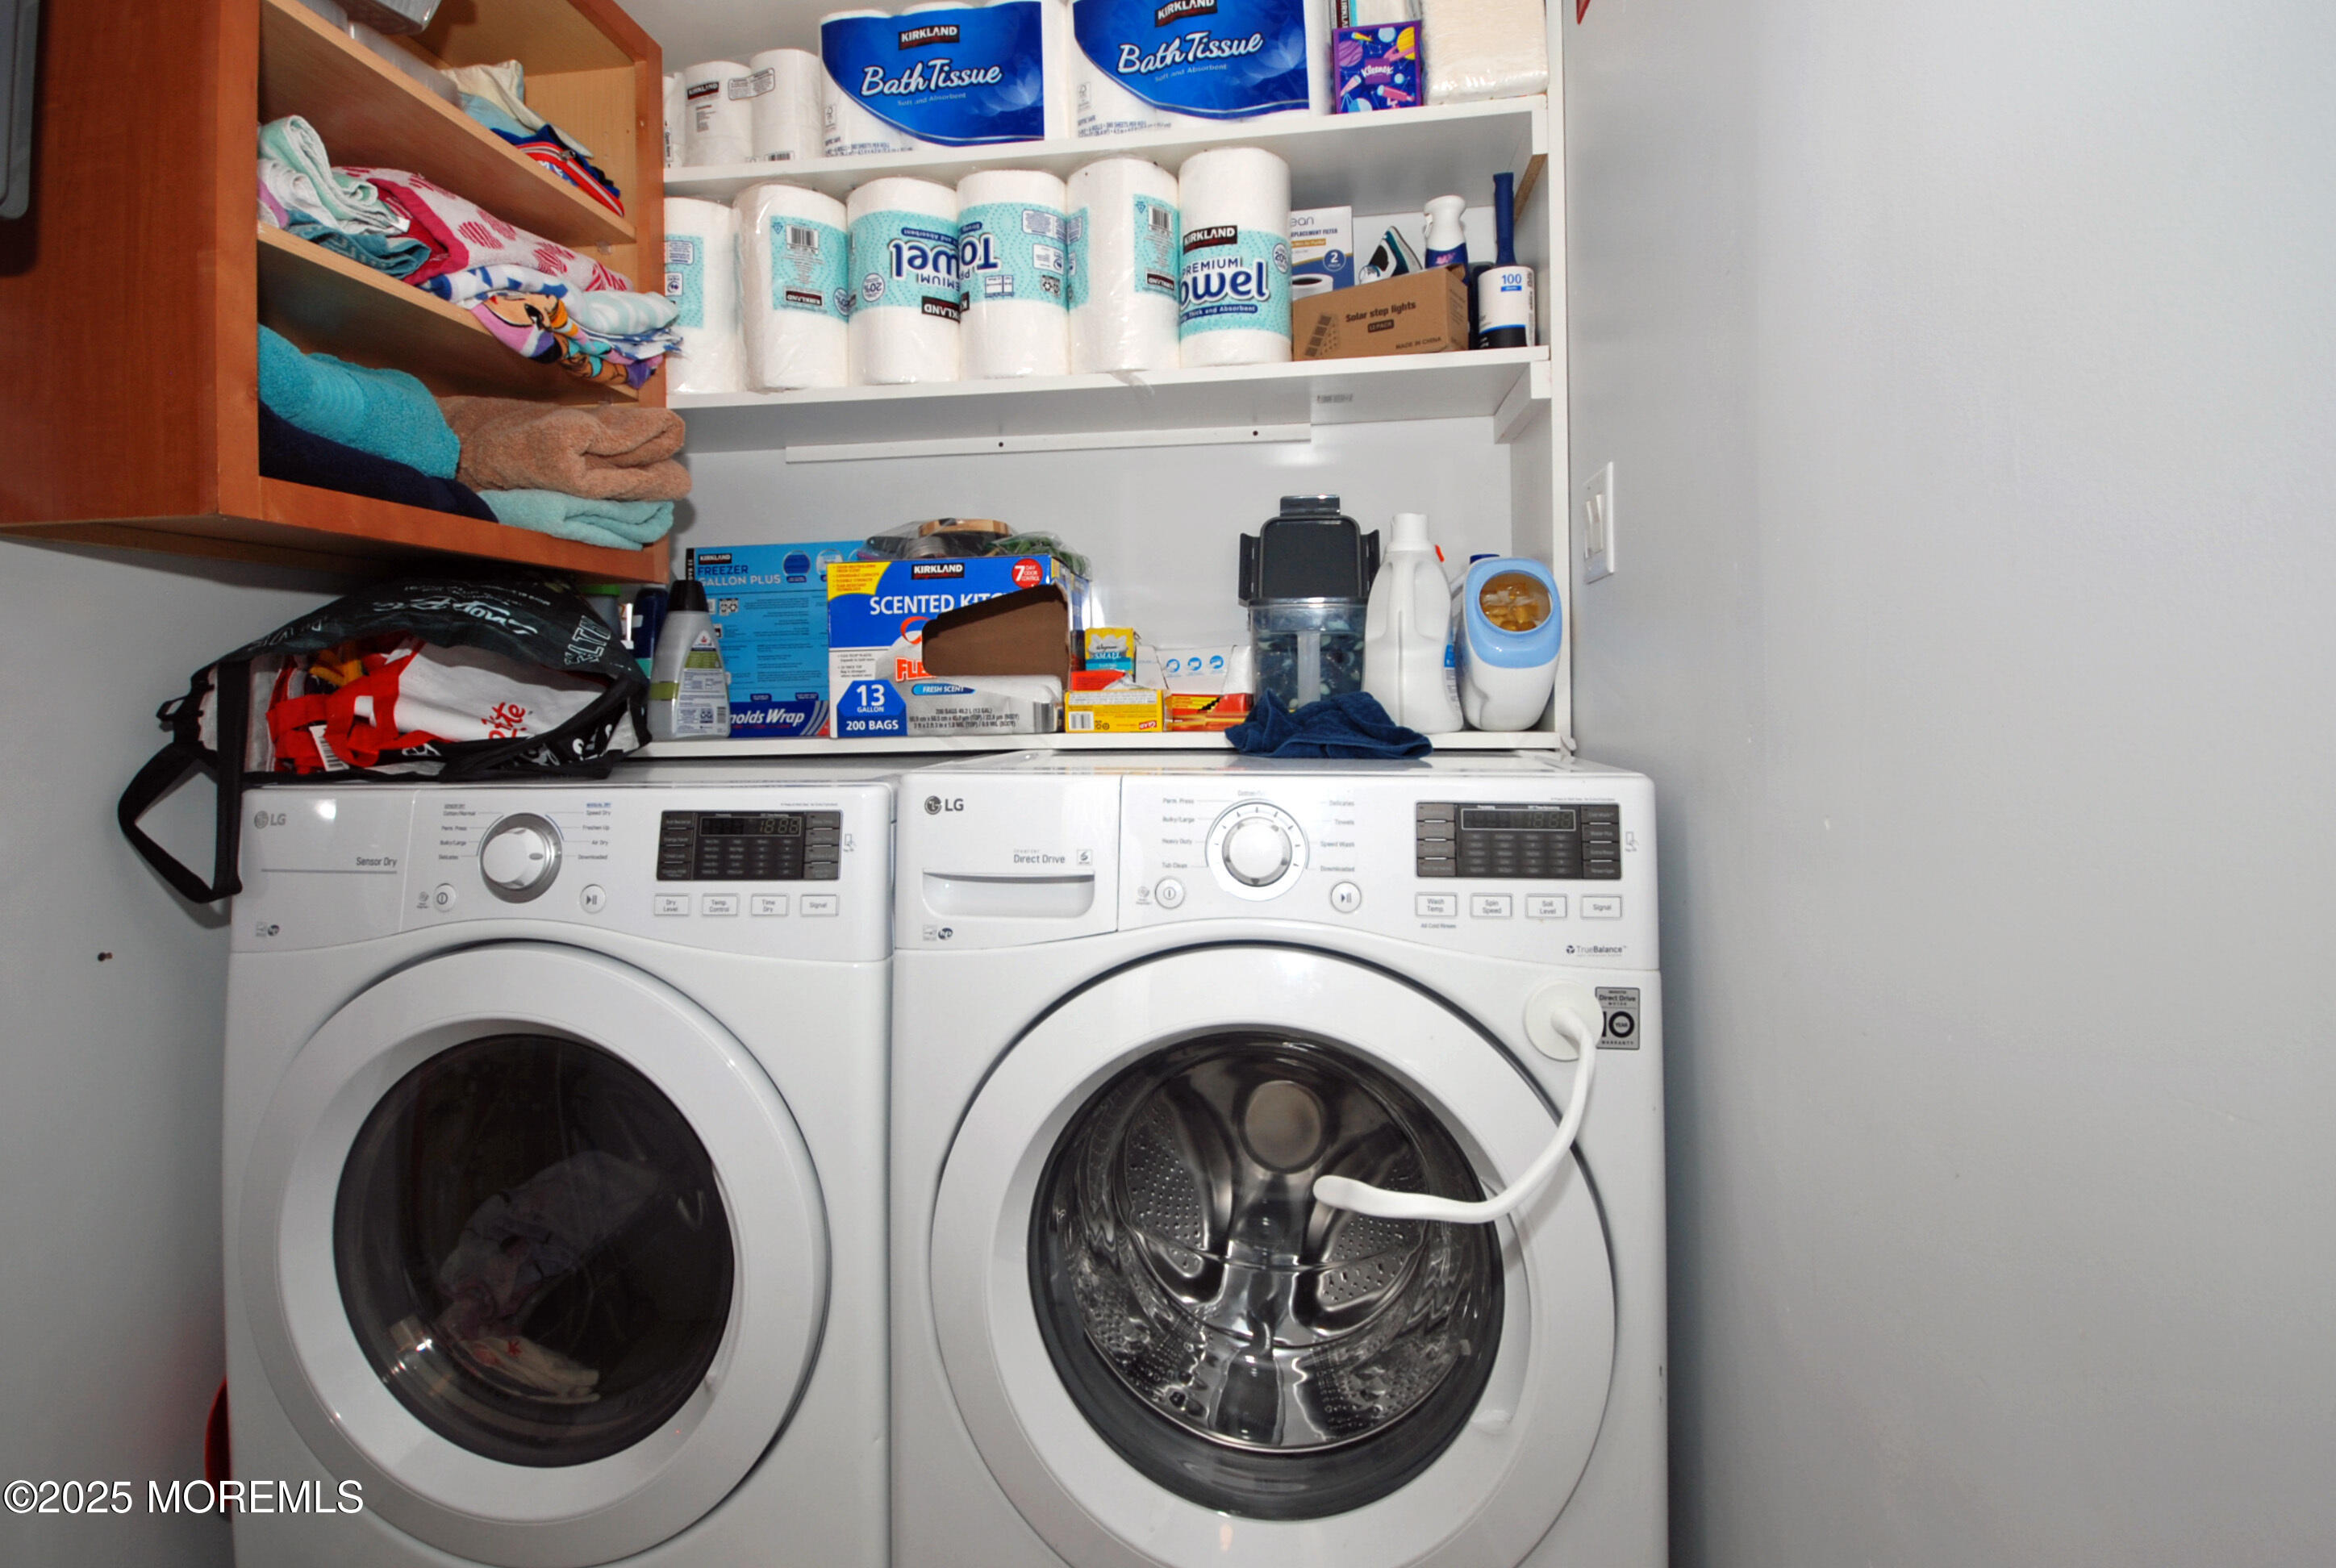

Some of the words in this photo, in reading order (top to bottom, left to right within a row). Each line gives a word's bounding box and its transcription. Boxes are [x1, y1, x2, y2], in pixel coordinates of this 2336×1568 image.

[1158, 0, 1214, 19] KIRKLAND
[901, 26, 957, 42] KIRKLAND
[1118, 38, 1186, 73] Bath
[1186, 31, 1263, 62] Tissue
[861, 62, 928, 97] Bath
[928, 59, 1003, 90] Tissue
[1155, 73, 1169, 82] Soft
[1170, 69, 1185, 77] and
[1187, 64, 1227, 73] Absorbent
[898, 98, 913, 106] Soft
[1291, 216, 1315, 227] ean
[1184, 227, 1236, 244] KIRKLAND
[1291, 229, 1321, 238] EPLACEMENT
[1330, 252, 1339, 263] 2
[1183, 257, 1239, 275] PREMIUM
[920, 273, 960, 292] EMIUM
[1181, 261, 1266, 307] owel
[1501, 273, 1522, 285] 100
[1345, 311, 1367, 323] Solar
[1370, 307, 1389, 319] step
[1391, 301, 1416, 315] lights
[699, 553, 731, 562] KIRKLAND
[698, 565, 749, 576] FREEZER
[914, 564, 963, 574] KIRKLAND
[1015, 565, 1026, 582] 7
[698, 575, 747, 587] GALLON
[750, 574, 782, 586] PLUS
[870, 594, 955, 615] SCENTED
[856, 684, 886, 706] 13
[923, 685, 942, 694] FRESH
[944, 685, 964, 693] SCENT
[729, 710, 765, 724] nolds
[765, 707, 805, 728] Wrap
[845, 720, 867, 731] 200
[869, 719, 899, 731] BAGS
[945, 798, 965, 811] LG
[270, 813, 286, 827] LG
[356, 856, 382, 867] Sensor
[383, 857, 398, 868] Dry
[1013, 854, 1041, 865] Direct
[1042, 854, 1066, 865] Drive
[665, 899, 677, 907] Dry
[809, 900, 828, 910] Signal
[1427, 898, 1445, 906] Wash
[1484, 898, 1500, 907] Spin
[1541, 899, 1554, 908] Soil
[1592, 902, 1612, 912] Signal
[663, 905, 678, 913] Level
[709, 905, 730, 913] Control
[762, 905, 774, 913] Dry
[1482, 906, 1503, 915] Speed
[1539, 907, 1557, 915] Level
[1599, 994, 1618, 1002] Direct
[1619, 995, 1637, 1003] Drive
